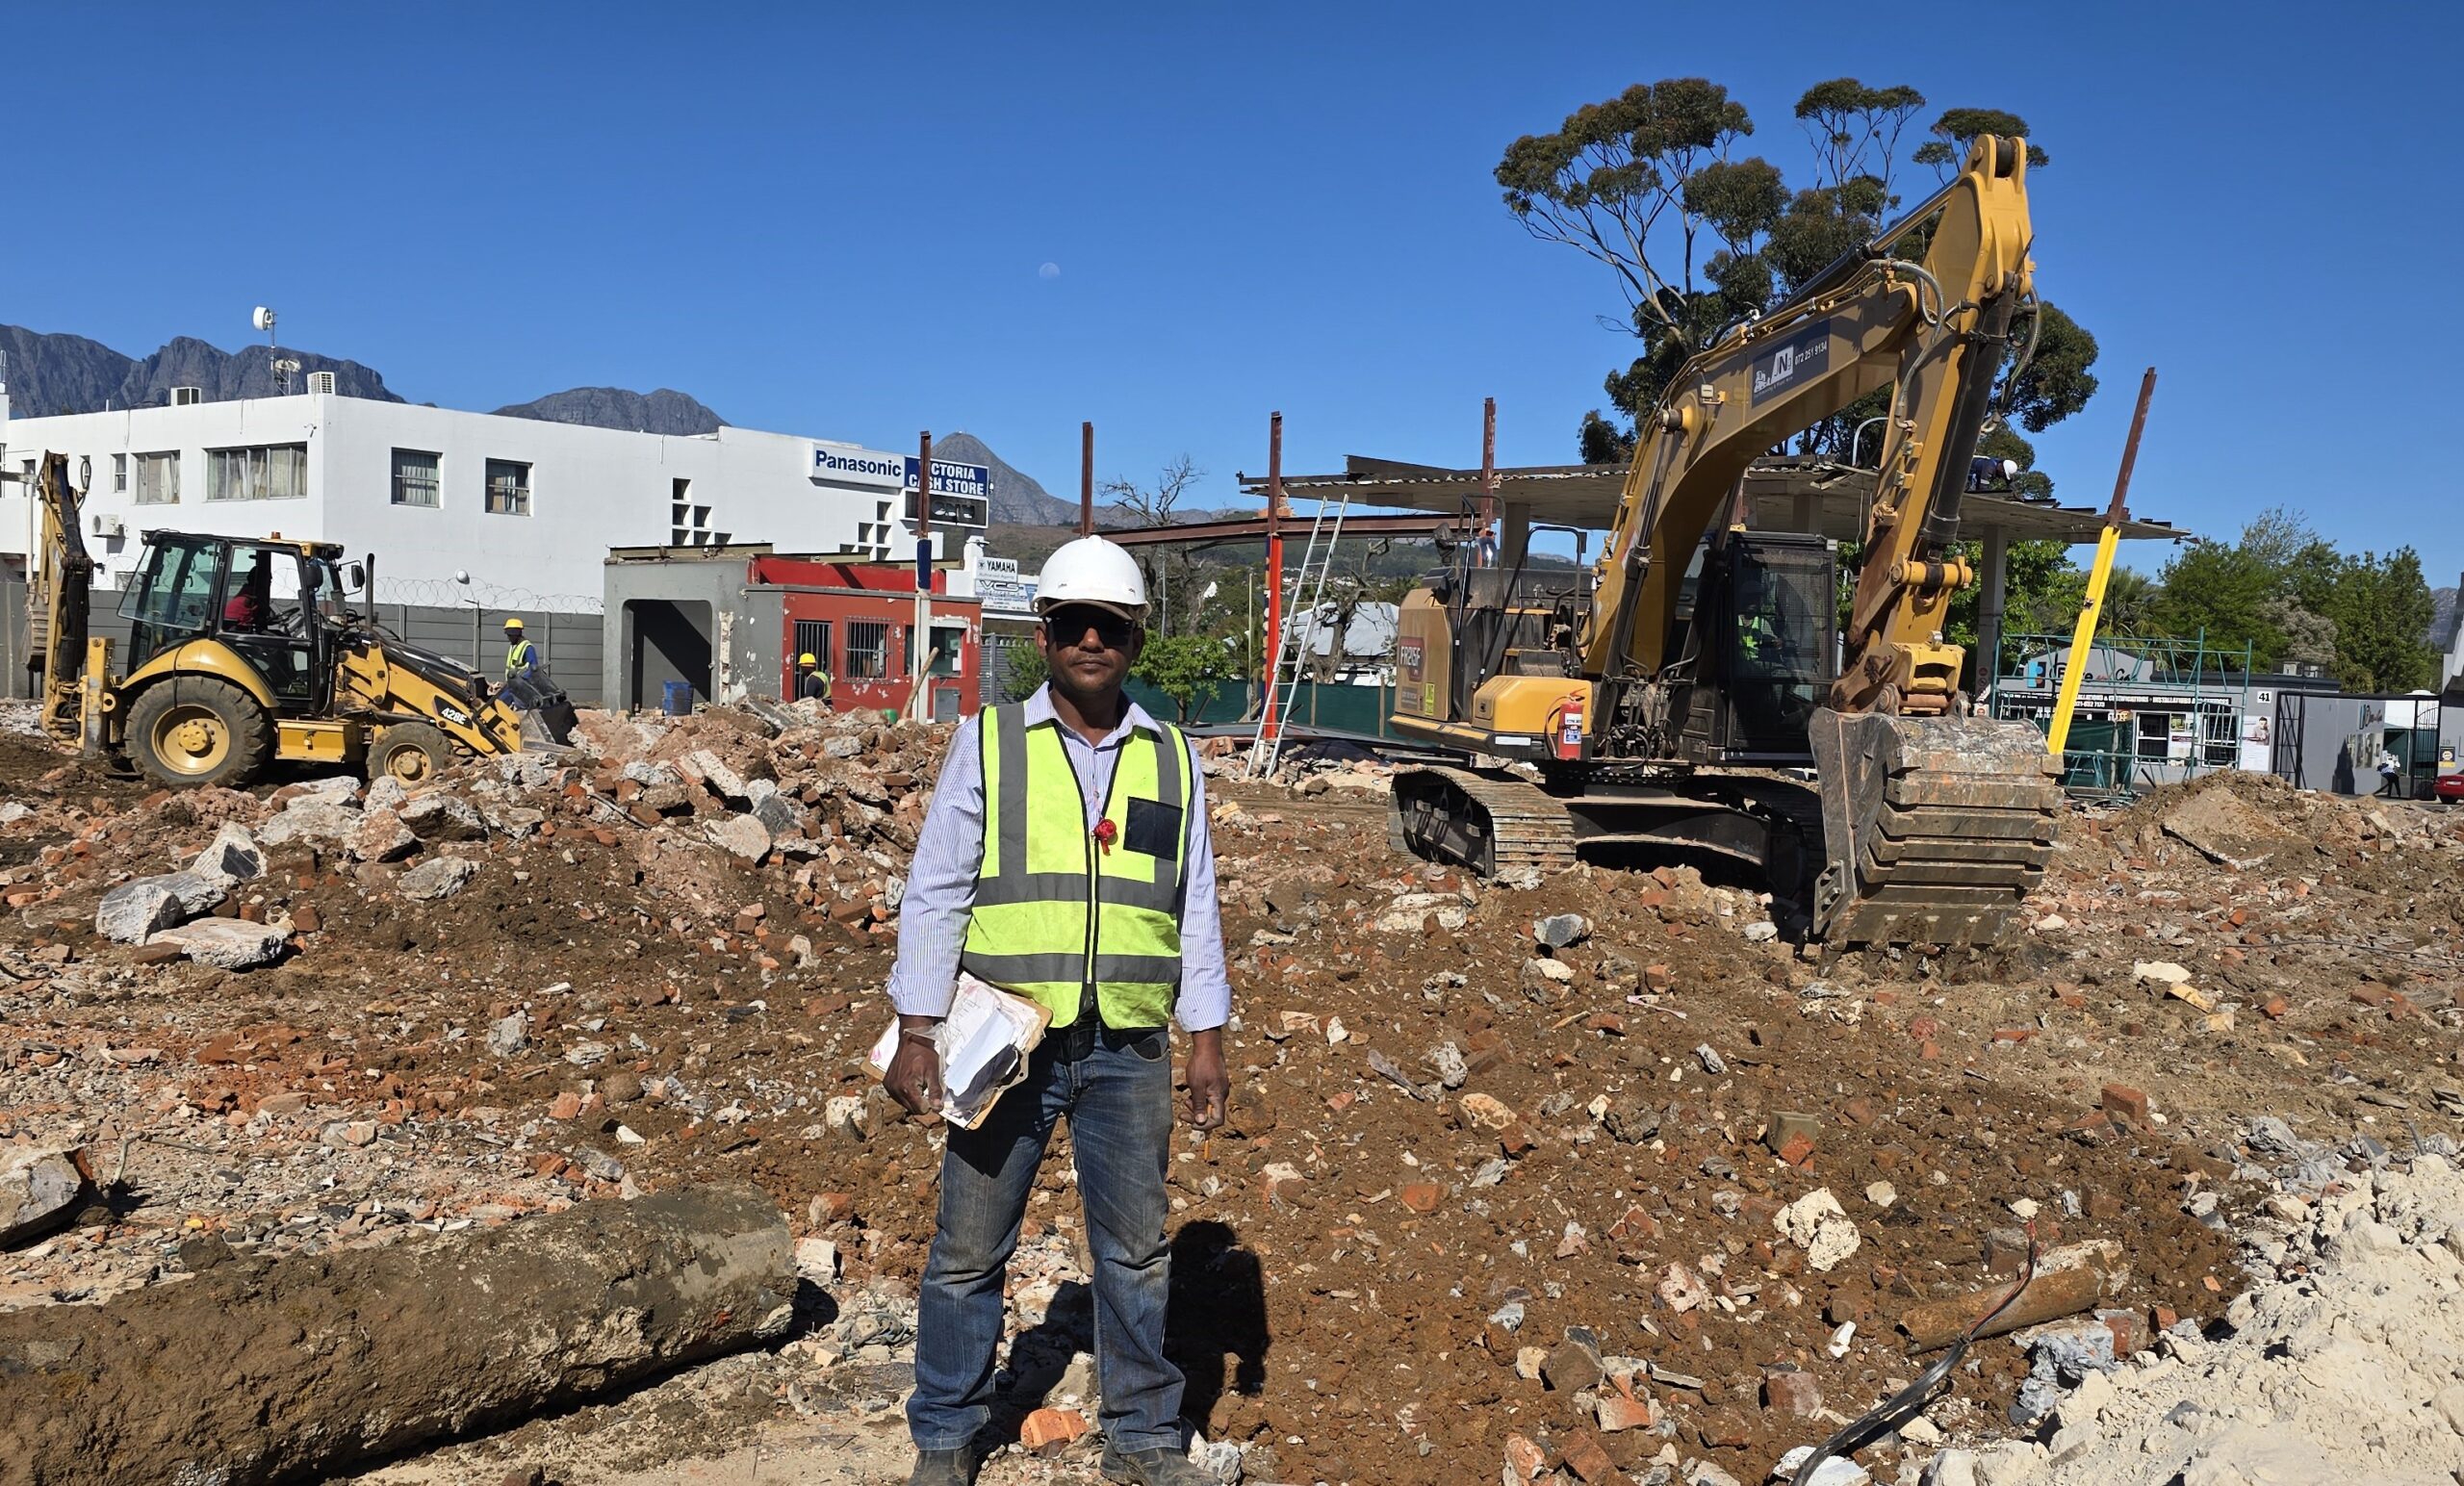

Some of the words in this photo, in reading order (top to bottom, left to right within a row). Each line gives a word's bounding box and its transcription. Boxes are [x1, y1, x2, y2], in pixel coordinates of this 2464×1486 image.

[1794, 352, 1805, 366] 072
[1805, 347, 1814, 361] 251
[815, 449, 901, 477] Panasonic
[918, 460, 976, 480] CTORIA
[945, 478, 985, 496] STORE
[987, 560, 1015, 574] YAMAHA
[2258, 692, 2271, 703] 41
[441, 707, 468, 725] 428E
